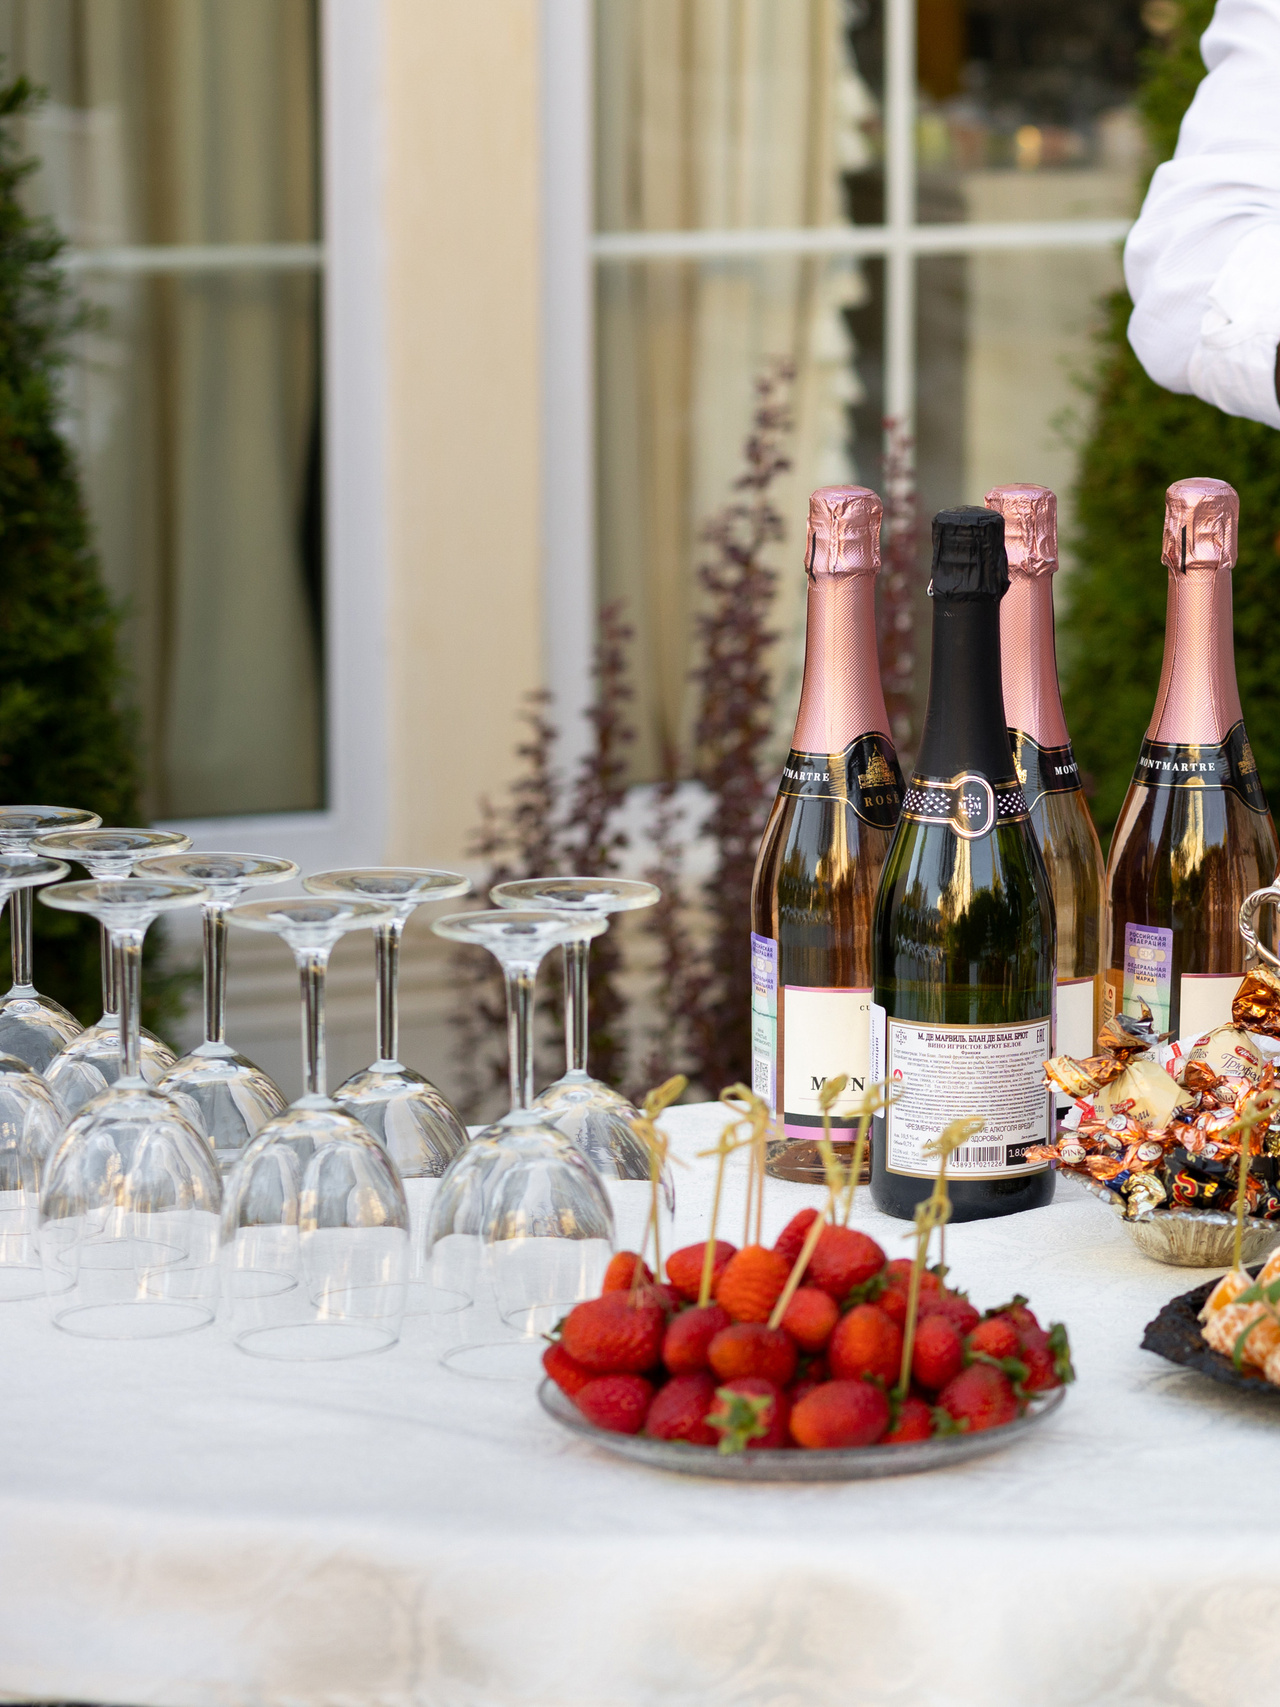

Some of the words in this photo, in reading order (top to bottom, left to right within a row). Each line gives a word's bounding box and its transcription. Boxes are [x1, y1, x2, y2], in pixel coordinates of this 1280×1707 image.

[1140, 756, 1216, 772] MONTMARTRE
[1129, 931, 1167, 942] РОССИЙСКАЯ
[1129, 937, 1167, 948] ФЕДЕРАЦИЯ
[1126, 967, 1166, 979] СПЕЦИАЛЬНАЯ
[1127, 962, 1167, 973] ФЕДЕРАЛЬНАЯ
[1135, 975, 1155, 984] МАРКА
[925, 1033, 934, 1042] ДЕ
[968, 1035, 986, 1043] БЛАН
[987, 1034, 996, 1043] ДЕ
[1014, 1031, 1029, 1040] БРЮТ
[1003, 1041, 1022, 1049] БЕЛОЕ
[811, 1076, 866, 1092] MN
[905, 1122, 941, 1133] ЧРЕЗМЕРНОЕ
[989, 1123, 1017, 1133] АЛКОГОЛЯ
[1017, 1121, 1035, 1131] ВРЕДИТ
[970, 1134, 1004, 1143] ЗДОРОВЬЮ
